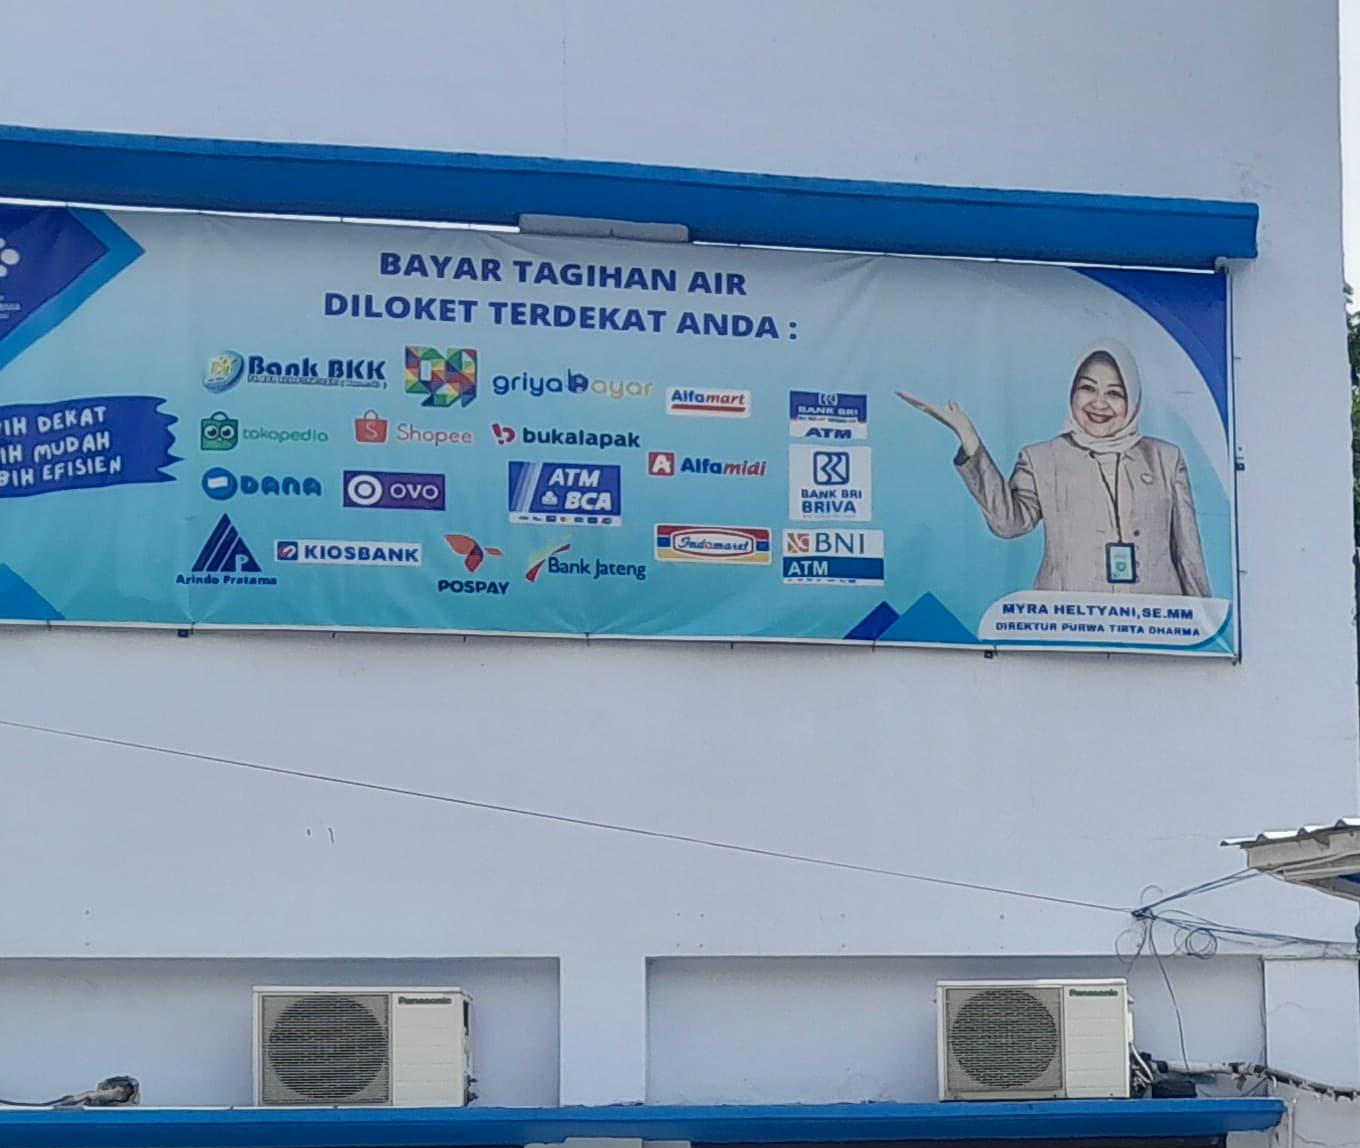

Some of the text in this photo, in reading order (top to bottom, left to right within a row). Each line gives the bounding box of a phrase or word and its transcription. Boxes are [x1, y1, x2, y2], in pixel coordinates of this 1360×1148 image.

[379, 252, 747, 296] BAYAR TAGIHAN AIR
[324, 292, 478, 323] DILOKET
[489, 301, 667, 332] TERDEKAT
[677, 311, 780, 340] ANDA
[248, 355, 386, 380] Bank BKK
[671, 389, 746, 405] Alfamart
[798, 405, 858, 416] BANK BRI
[37, 406, 107, 433] DEKAT
[243, 427, 328, 444] tokopedia
[397, 424, 473, 447] Shopee
[522, 428, 640, 449] bukalapak
[805, 427, 852, 439] ATM
[34, 431, 110, 464] MUDAH
[43, 455, 121, 481] EFISIEN
[681, 458, 767, 477] Alfamidi
[240, 476, 322, 496] DANA
[548, 468, 600, 487] ATM
[390, 483, 439, 500] OVO
[801, 489, 862, 499] BANK BRI
[564, 491, 612, 511] BCA
[802, 500, 857, 513] BRIVA
[678, 536, 749, 551] Indomaret
[815, 532, 865, 554] BNI
[304, 545, 419, 562] KIOSBANK
[549, 557, 647, 580] Bank Jateng
[788, 560, 829, 576] ATM
[176, 574, 277, 585] Arindo Pratama
[438, 580, 510, 595] POSPAY
[1002, 603, 1049, 616] MYRA
[995, 622, 1200, 637] DIREKTUR PURWA TIRTA DHARMA
[398, 996, 452, 1005] Panasonic
